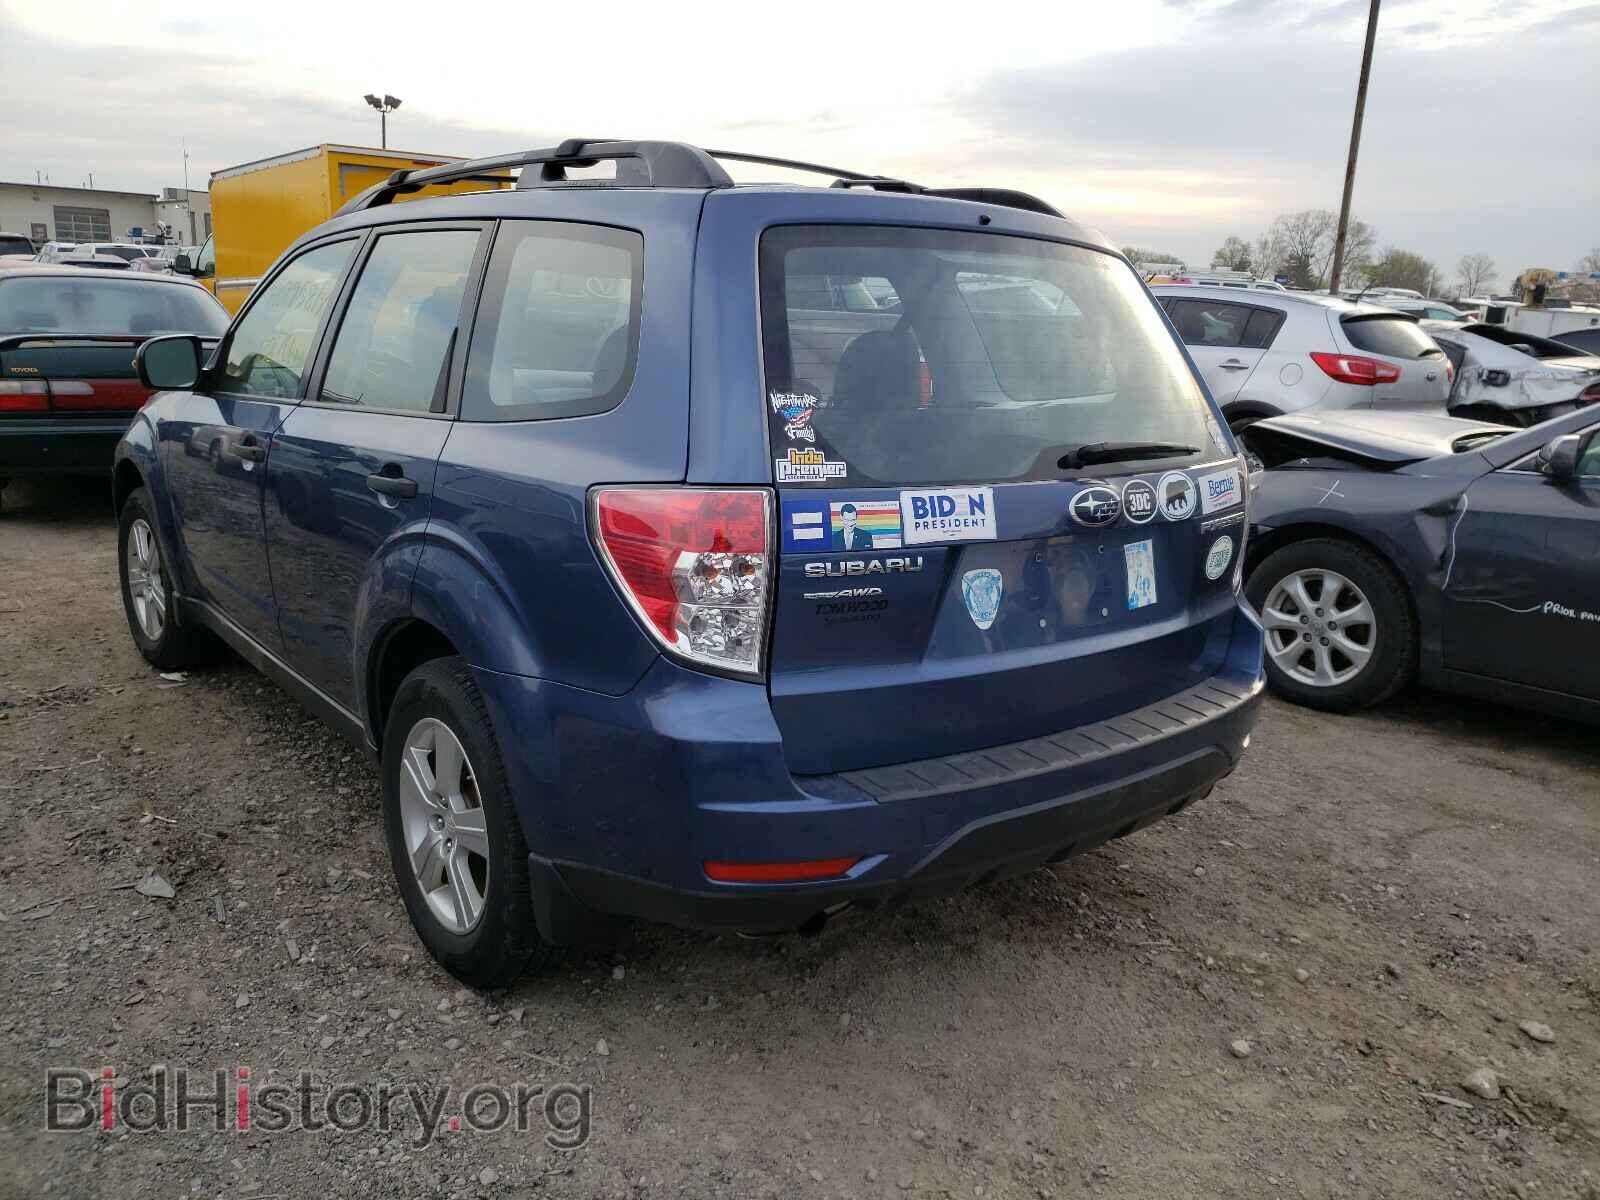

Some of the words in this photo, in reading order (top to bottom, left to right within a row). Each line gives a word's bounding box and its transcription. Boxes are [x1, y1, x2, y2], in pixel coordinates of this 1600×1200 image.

[790, 448, 823, 465] Indy
[778, 461, 847, 480] Premier
[1208, 476, 1234, 497] Bernie
[914, 518, 987, 531] PRESIDENT
[804, 556, 923, 578] SUBARU
[840, 587, 882, 598] AWD
